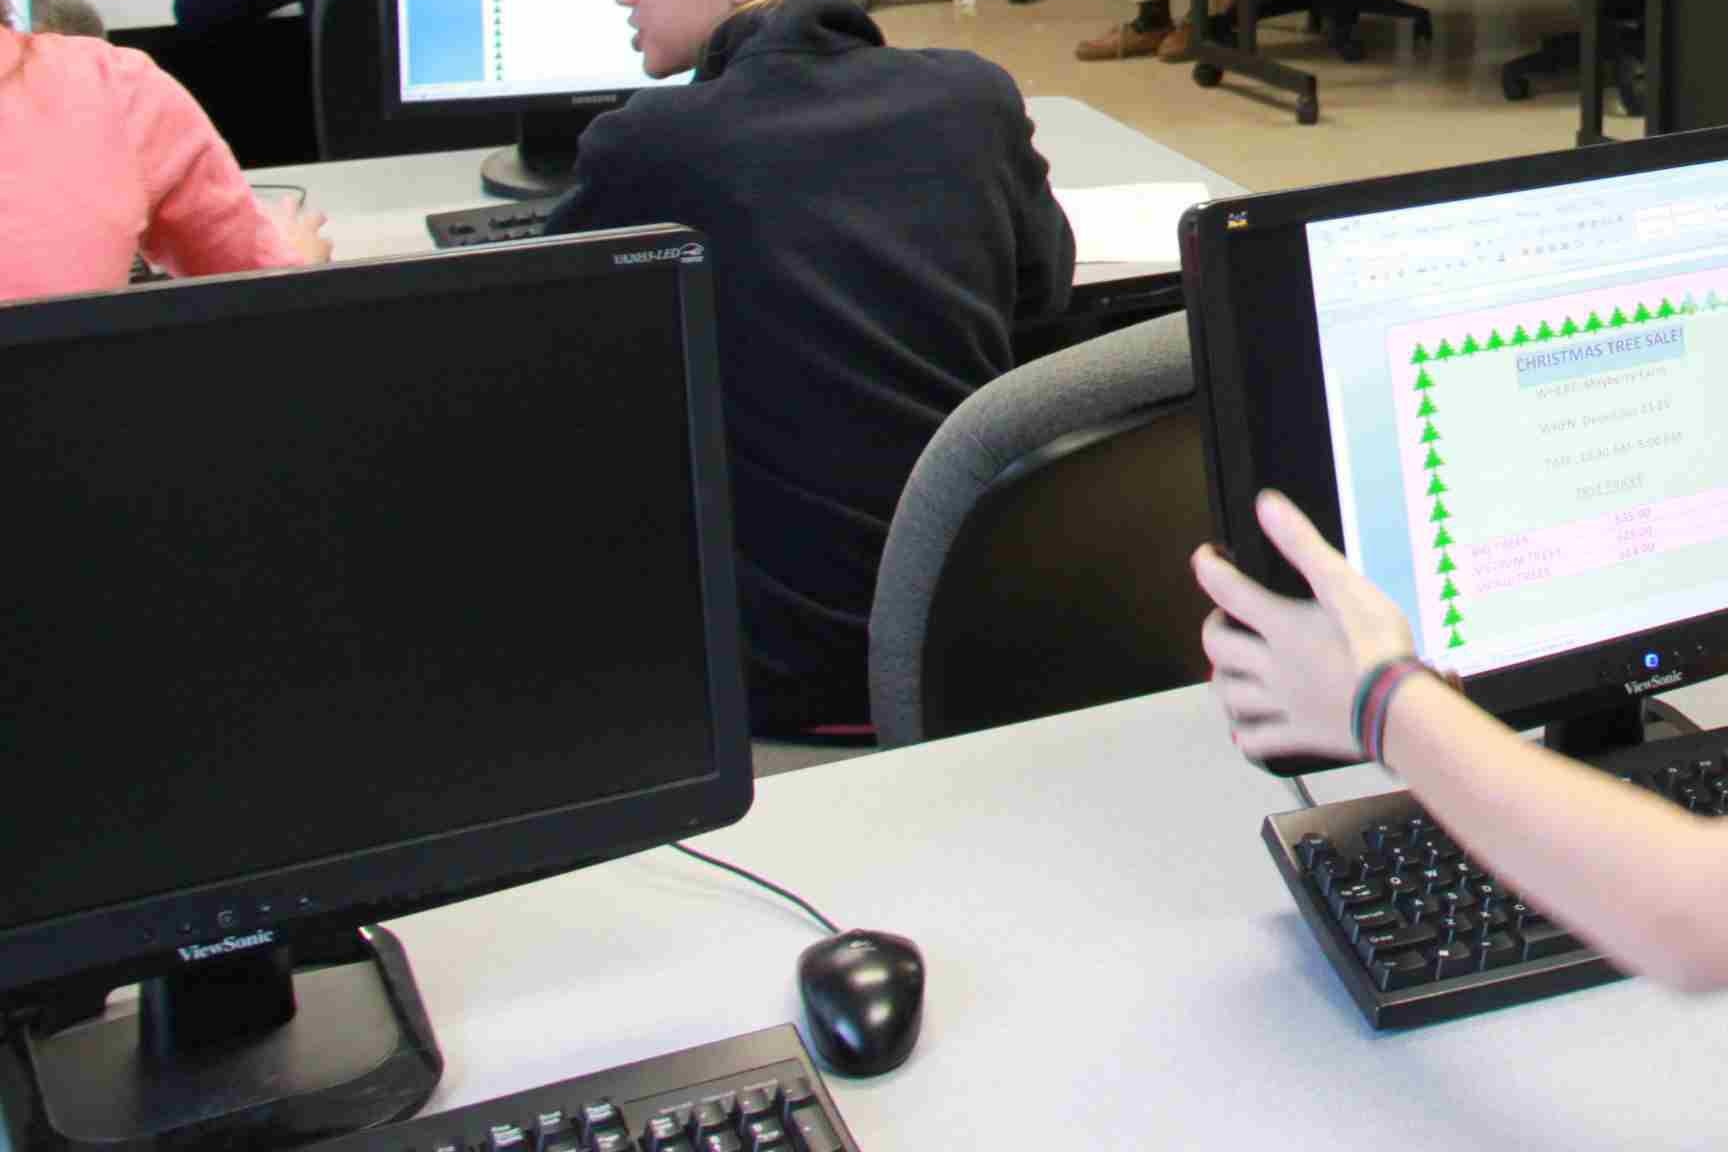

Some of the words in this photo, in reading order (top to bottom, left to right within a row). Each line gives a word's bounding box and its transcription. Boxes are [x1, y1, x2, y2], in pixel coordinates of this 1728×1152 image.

[1516, 343, 1603, 372] CHRISTMAS
[1607, 337, 1641, 355] TREE
[1624, 669, 1683, 694] ViewSonic
[178, 929, 273, 961] ViewSonic
